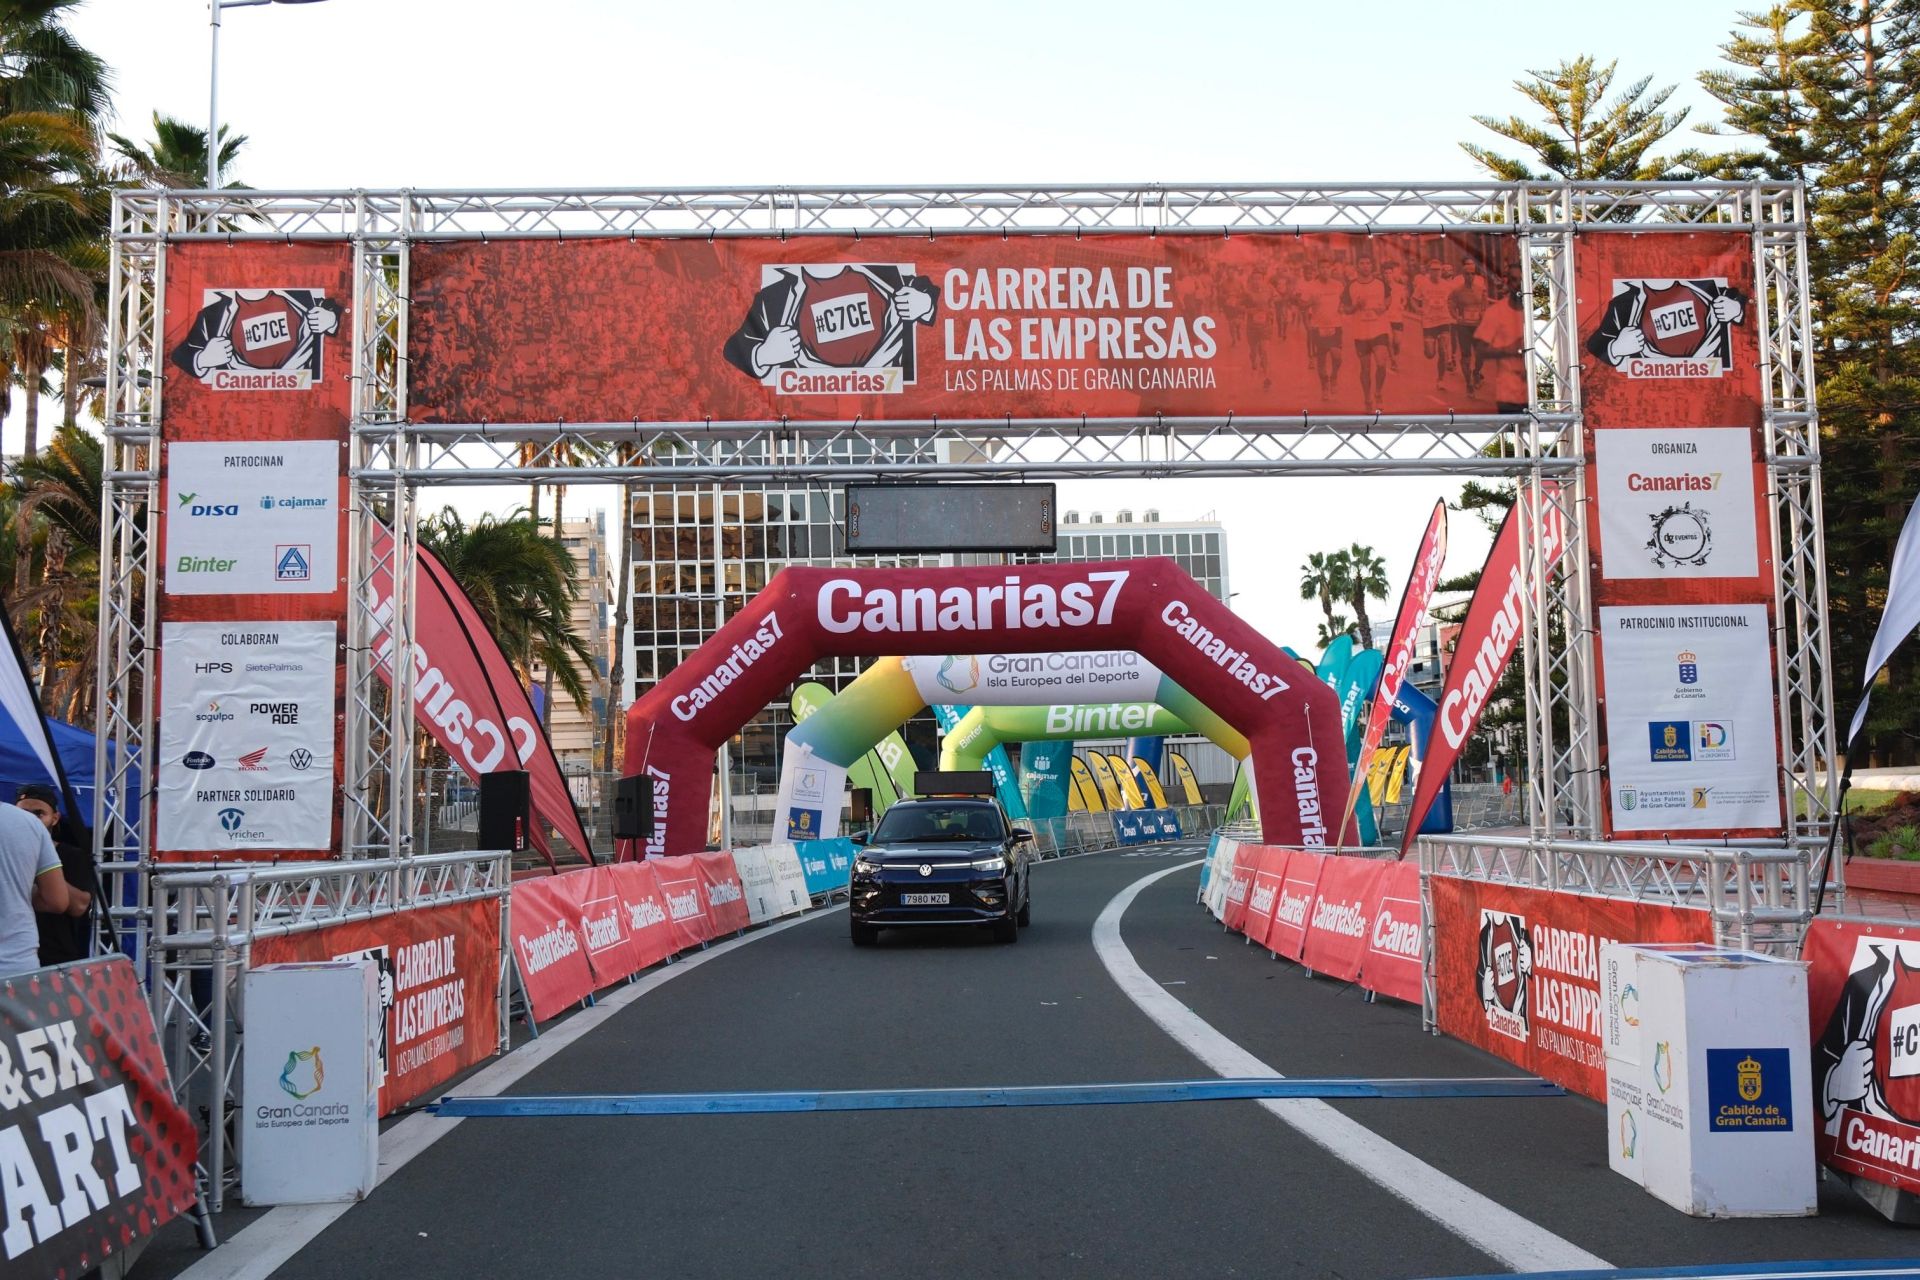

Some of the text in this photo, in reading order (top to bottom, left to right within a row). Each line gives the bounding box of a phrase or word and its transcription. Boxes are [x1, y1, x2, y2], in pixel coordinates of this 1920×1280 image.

[944, 266, 1173, 310] CARRERA DE
[816, 302, 871, 334] #C7CE
[1654, 306, 1697, 332] #C7CE
[245, 317, 288, 343] #C7CE
[944, 315, 1217, 361] LAS EMPRESAS
[1630, 359, 1719, 377] Canarias7
[215, 371, 307, 389] Canarias7
[780, 369, 896, 393] Canarias7
[945, 366, 1216, 392] LAS PALMAS DE GRAN CANARIA
[1651, 443, 1698, 454] ORGANIZA
[224, 455, 283, 467] PATROCINAN
[1627, 472, 1722, 492] Canarias7
[278, 496, 328, 509] cajamar
[177, 556, 237, 573] Binter
[281, 570, 305, 578] ALDI
[817, 570, 1130, 633] Canarias7
[1620, 616, 1748, 629] PATROCINIO INSTITUCIONAL
[221, 633, 279, 645] COLABORAN
[1161, 600, 1290, 701] Canarias7
[195, 662, 233, 673] HPS
[670, 611, 785, 722] Canarias7
[988, 652, 1138, 673] Gran Canaria
[987, 670, 1139, 688] Isla Europea del Deporte
[250, 703, 298, 714] POWER
[272, 714, 298, 724] ADE
[1046, 703, 1165, 734] Binter
[197, 789, 295, 802] PARTNER SOLIDARIO
[906, 894, 947, 904] 7980 MZC
[1534, 924, 1598, 982] CARRERA
[396, 934, 456, 993] CARRERA DE
[396, 978, 465, 1045] LAS EMPRESAS
[1535, 974, 1600, 1037] LAS EMPR
[1537, 1026, 1549, 1050] LAS
[1550, 1030, 1576, 1060] PALMAS
[1576, 1039, 1586, 1064] DE
[396, 1049, 407, 1077] LAS
[408, 1042, 427, 1070] PALMAS
[257, 1102, 349, 1119] Gran Canaria
[1720, 1104, 1779, 1115] Cabildo de
[256, 1120, 269, 1128] Isla
[271, 1120, 302, 1129] Europea
[318, 1117, 350, 1126] Deporte
[1716, 1115, 1787, 1126] Gran Canaria
